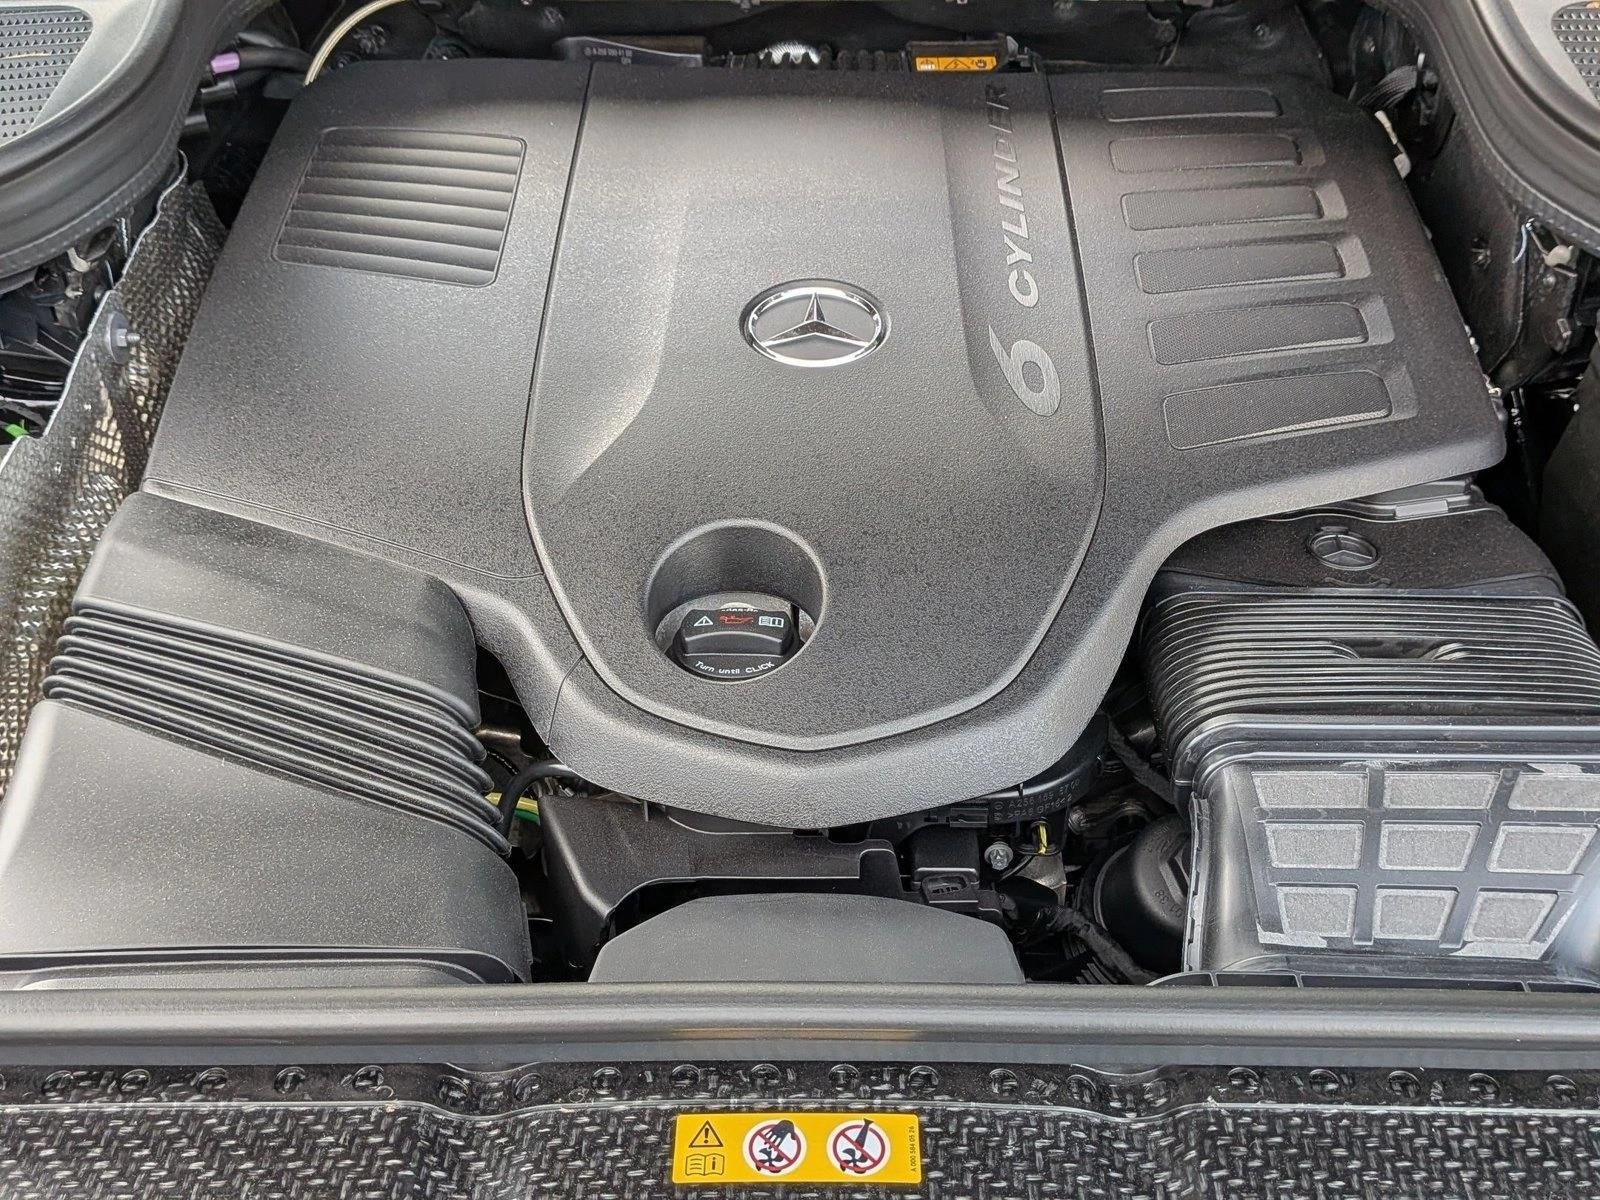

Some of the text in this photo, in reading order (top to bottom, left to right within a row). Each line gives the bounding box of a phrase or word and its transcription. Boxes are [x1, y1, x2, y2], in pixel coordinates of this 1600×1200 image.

[985, 83, 1061, 416] 6 CYLINDER
[694, 660, 715, 672] Turn
[745, 661, 775, 673] CLICK
